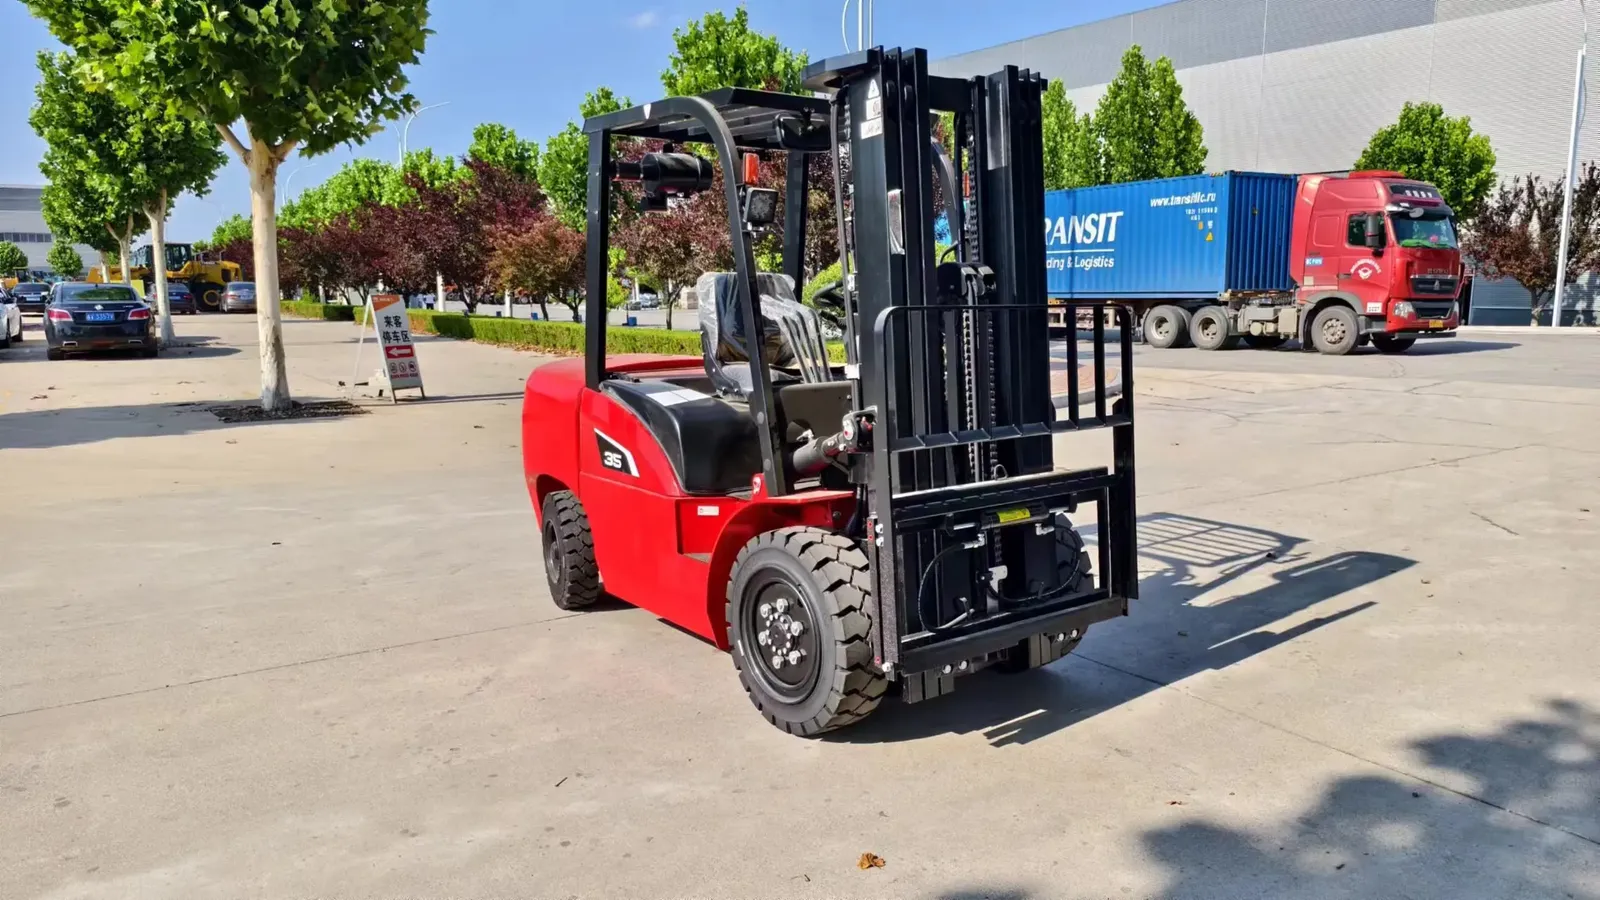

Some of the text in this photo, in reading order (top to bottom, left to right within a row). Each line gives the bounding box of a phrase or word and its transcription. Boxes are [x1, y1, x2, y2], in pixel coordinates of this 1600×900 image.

[1067, 256, 1073, 269] &
[1075, 256, 1115, 271] Logistics
[384, 315, 402, 328] 来客
[383, 330, 410, 344] 停车区
[604, 451, 621, 468] 35
